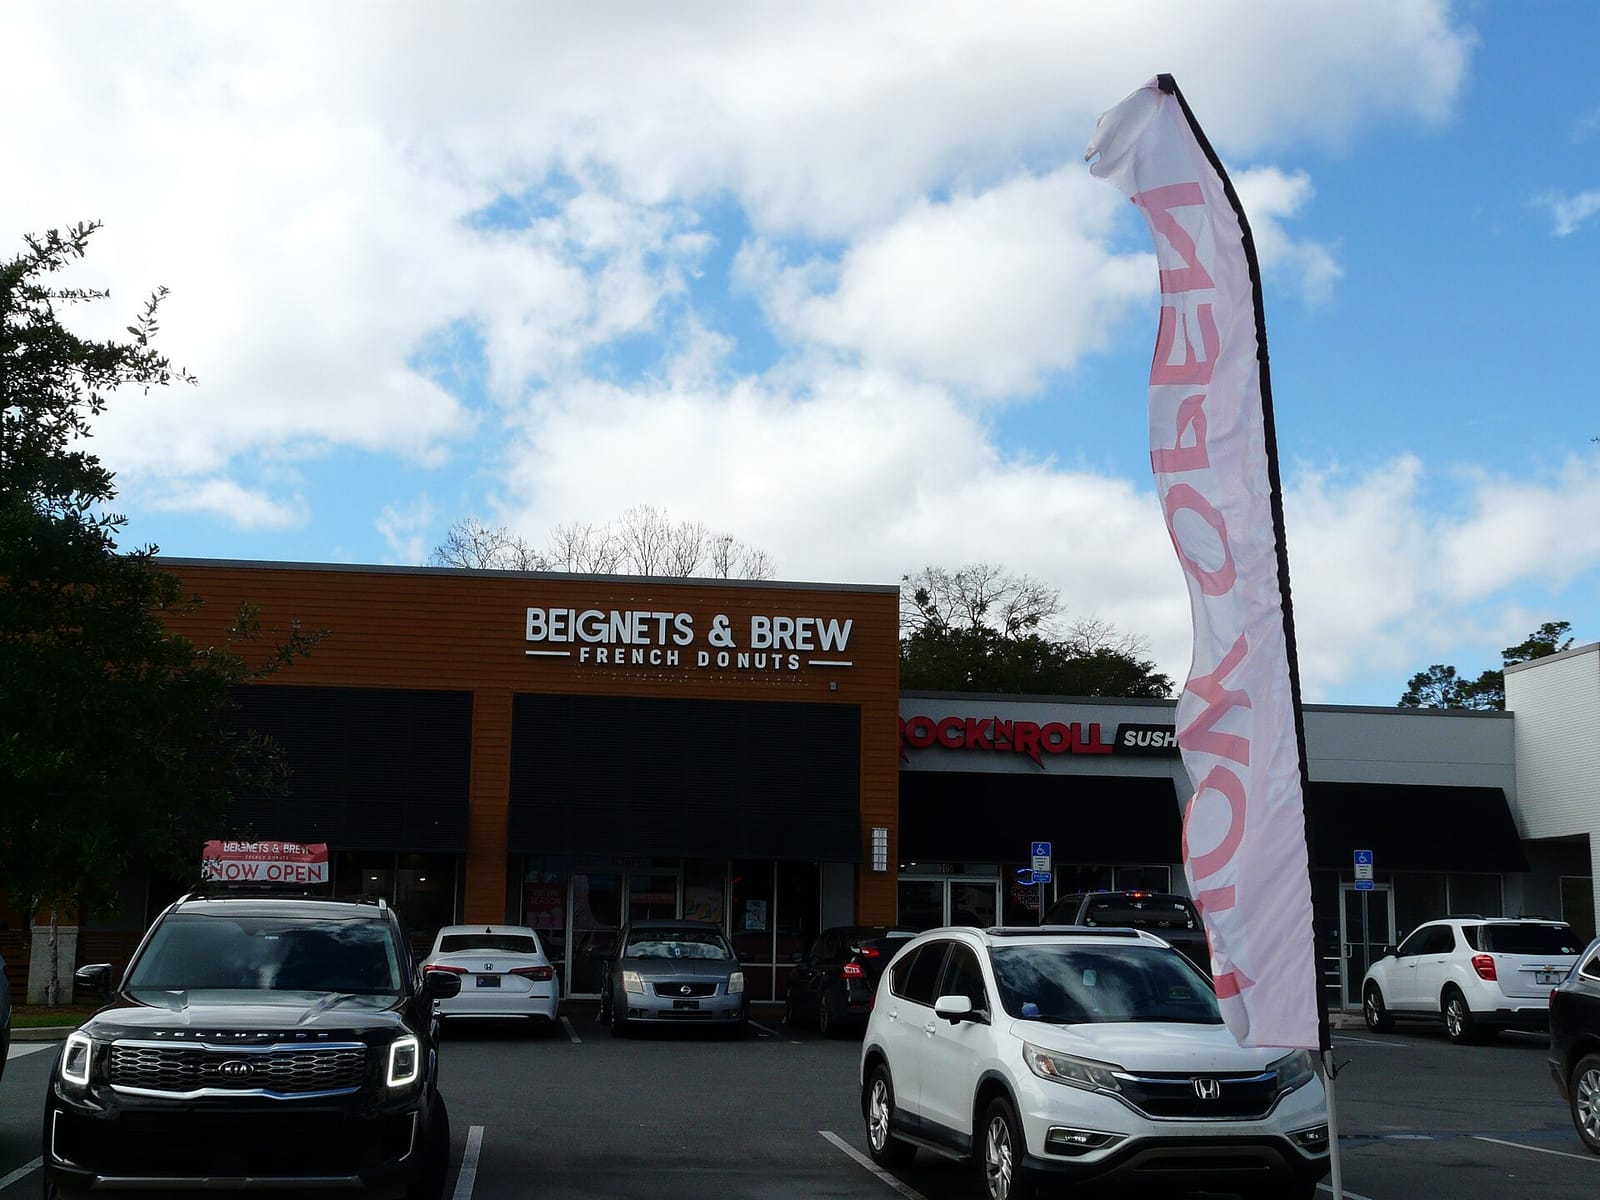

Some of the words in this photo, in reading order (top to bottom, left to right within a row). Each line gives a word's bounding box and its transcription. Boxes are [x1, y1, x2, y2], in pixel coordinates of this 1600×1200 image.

[525, 607, 694, 646] BEIGNETS
[707, 614, 737, 648] &
[751, 615, 853, 651] BREW
[579, 647, 680, 666] FRENCH
[697, 651, 800, 670] DONUTS
[1013, 720, 1113, 769] ROLL
[1123, 730, 1178, 747] SUSH
[209, 863, 259, 880] NOW
[266, 864, 322, 881] OPEN
